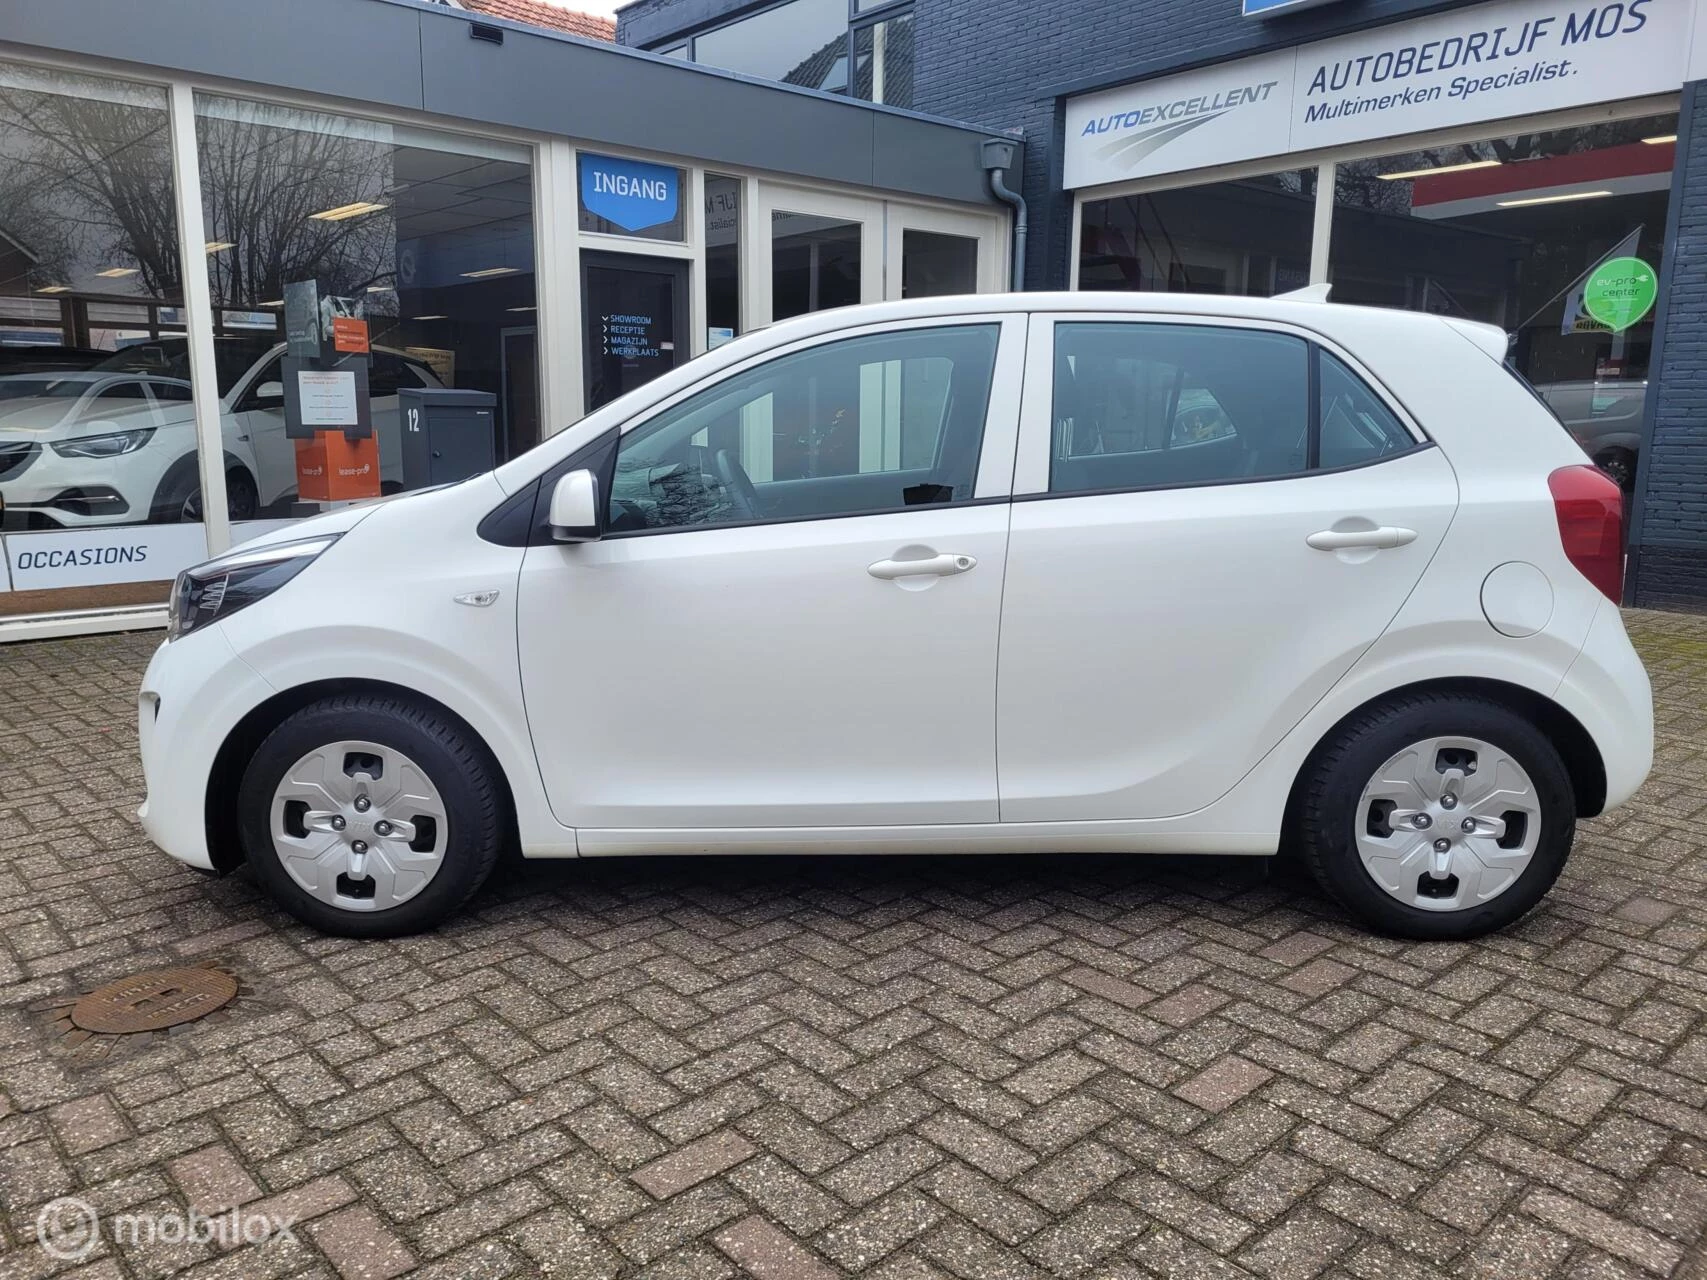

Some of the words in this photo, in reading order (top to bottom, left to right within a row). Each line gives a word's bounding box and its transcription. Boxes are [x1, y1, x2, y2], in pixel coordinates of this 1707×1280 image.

[1307, 17, 1556, 96] AUTOBEDRIJF
[1560, 0, 1651, 46] MOS
[1304, 85, 1441, 123] Multimerken
[1447, 58, 1579, 100] Specialist.
[1081, 81, 1279, 137] AUTOEXCELLENT
[593, 171, 668, 201] INGANG
[1597, 277, 1637, 287] ev-pro
[1602, 287, 1640, 297] center
[610, 314, 652, 325] SHOWROOM
[610, 325, 646, 335] RECEPTIE
[610, 336, 648, 346] MAGAZIJN
[611, 346, 660, 357] WERKPLAATS
[407, 408, 420, 432] 12
[338, 463, 370, 477] lease-pro
[17, 545, 148, 570] OCCASIONS
